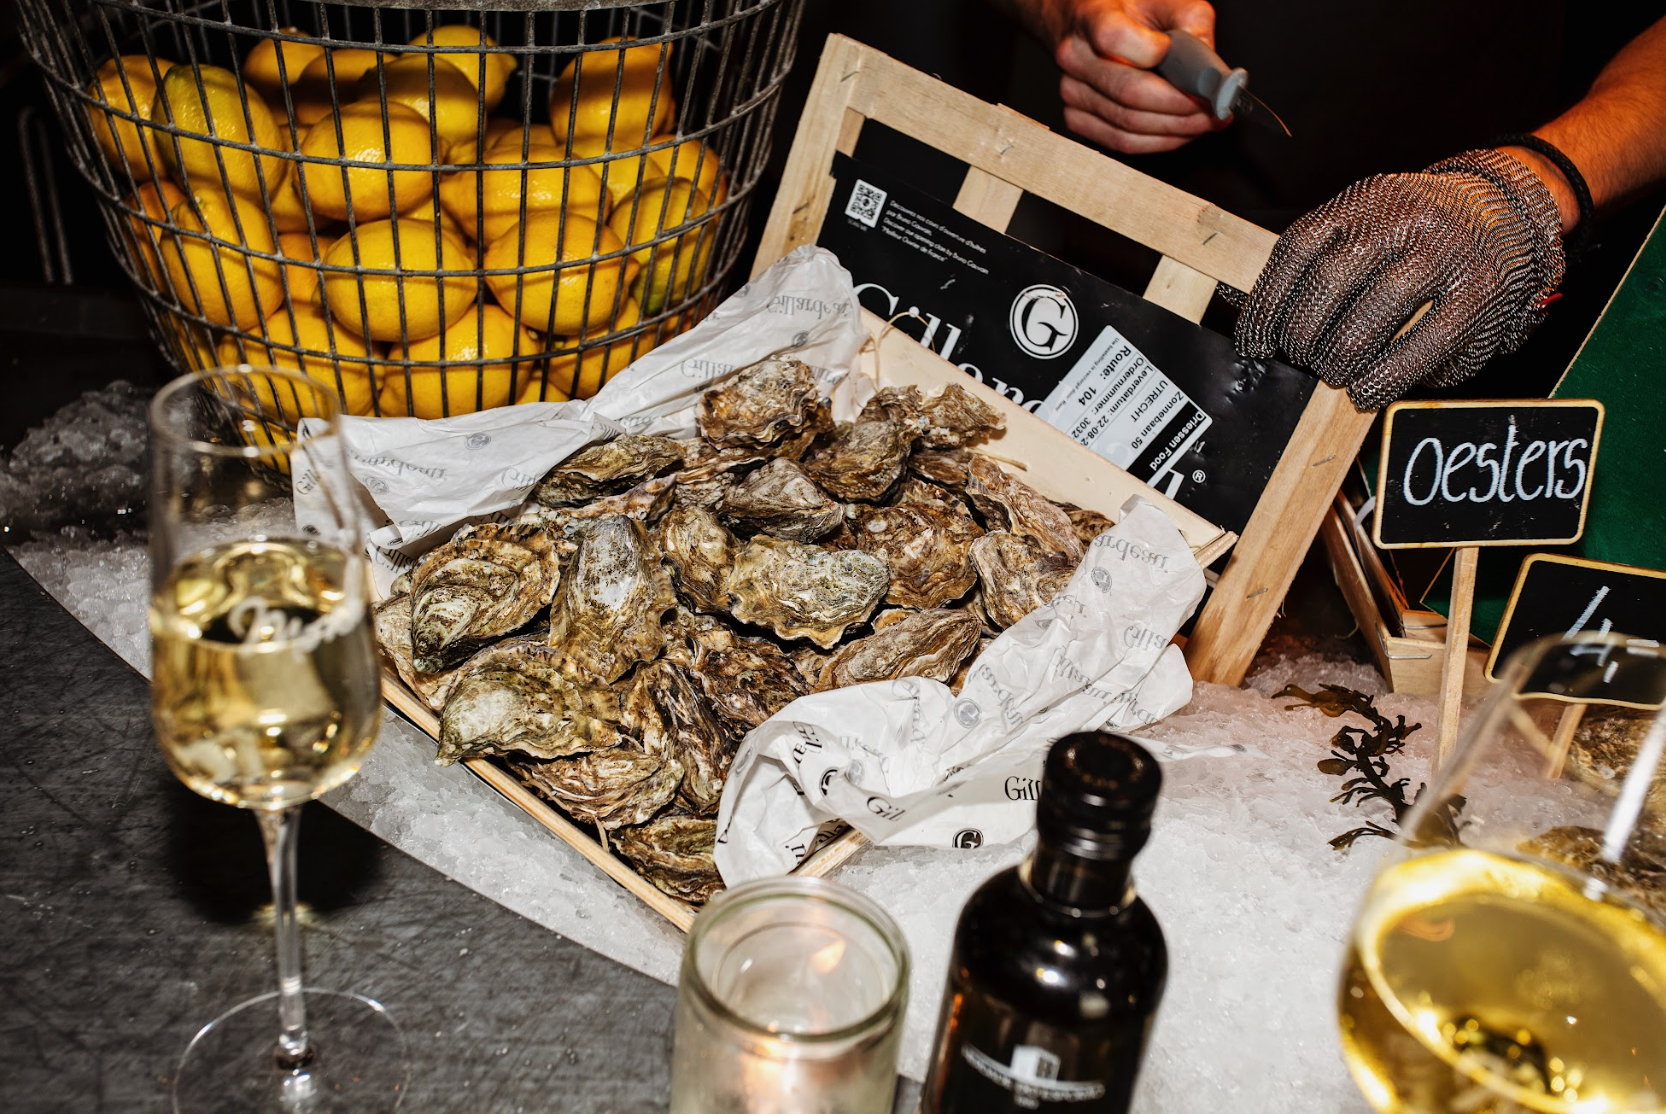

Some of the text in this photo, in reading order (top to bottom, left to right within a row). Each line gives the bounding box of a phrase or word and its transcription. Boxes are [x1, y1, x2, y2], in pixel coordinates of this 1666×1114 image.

[1079, 346, 1131, 405] Route: 104
[1095, 358, 1144, 414] Ordernummer:
[1110, 366, 1153, 415] Leverdatum:
[1131, 380, 1168, 422] UTRECHT
[1132, 392, 1183, 448] Zonnebaan 50
[1169, 409, 1205, 448] Driessen
[1150, 447, 1172, 471] Food
[1403, 415, 1588, 505] Oesters
